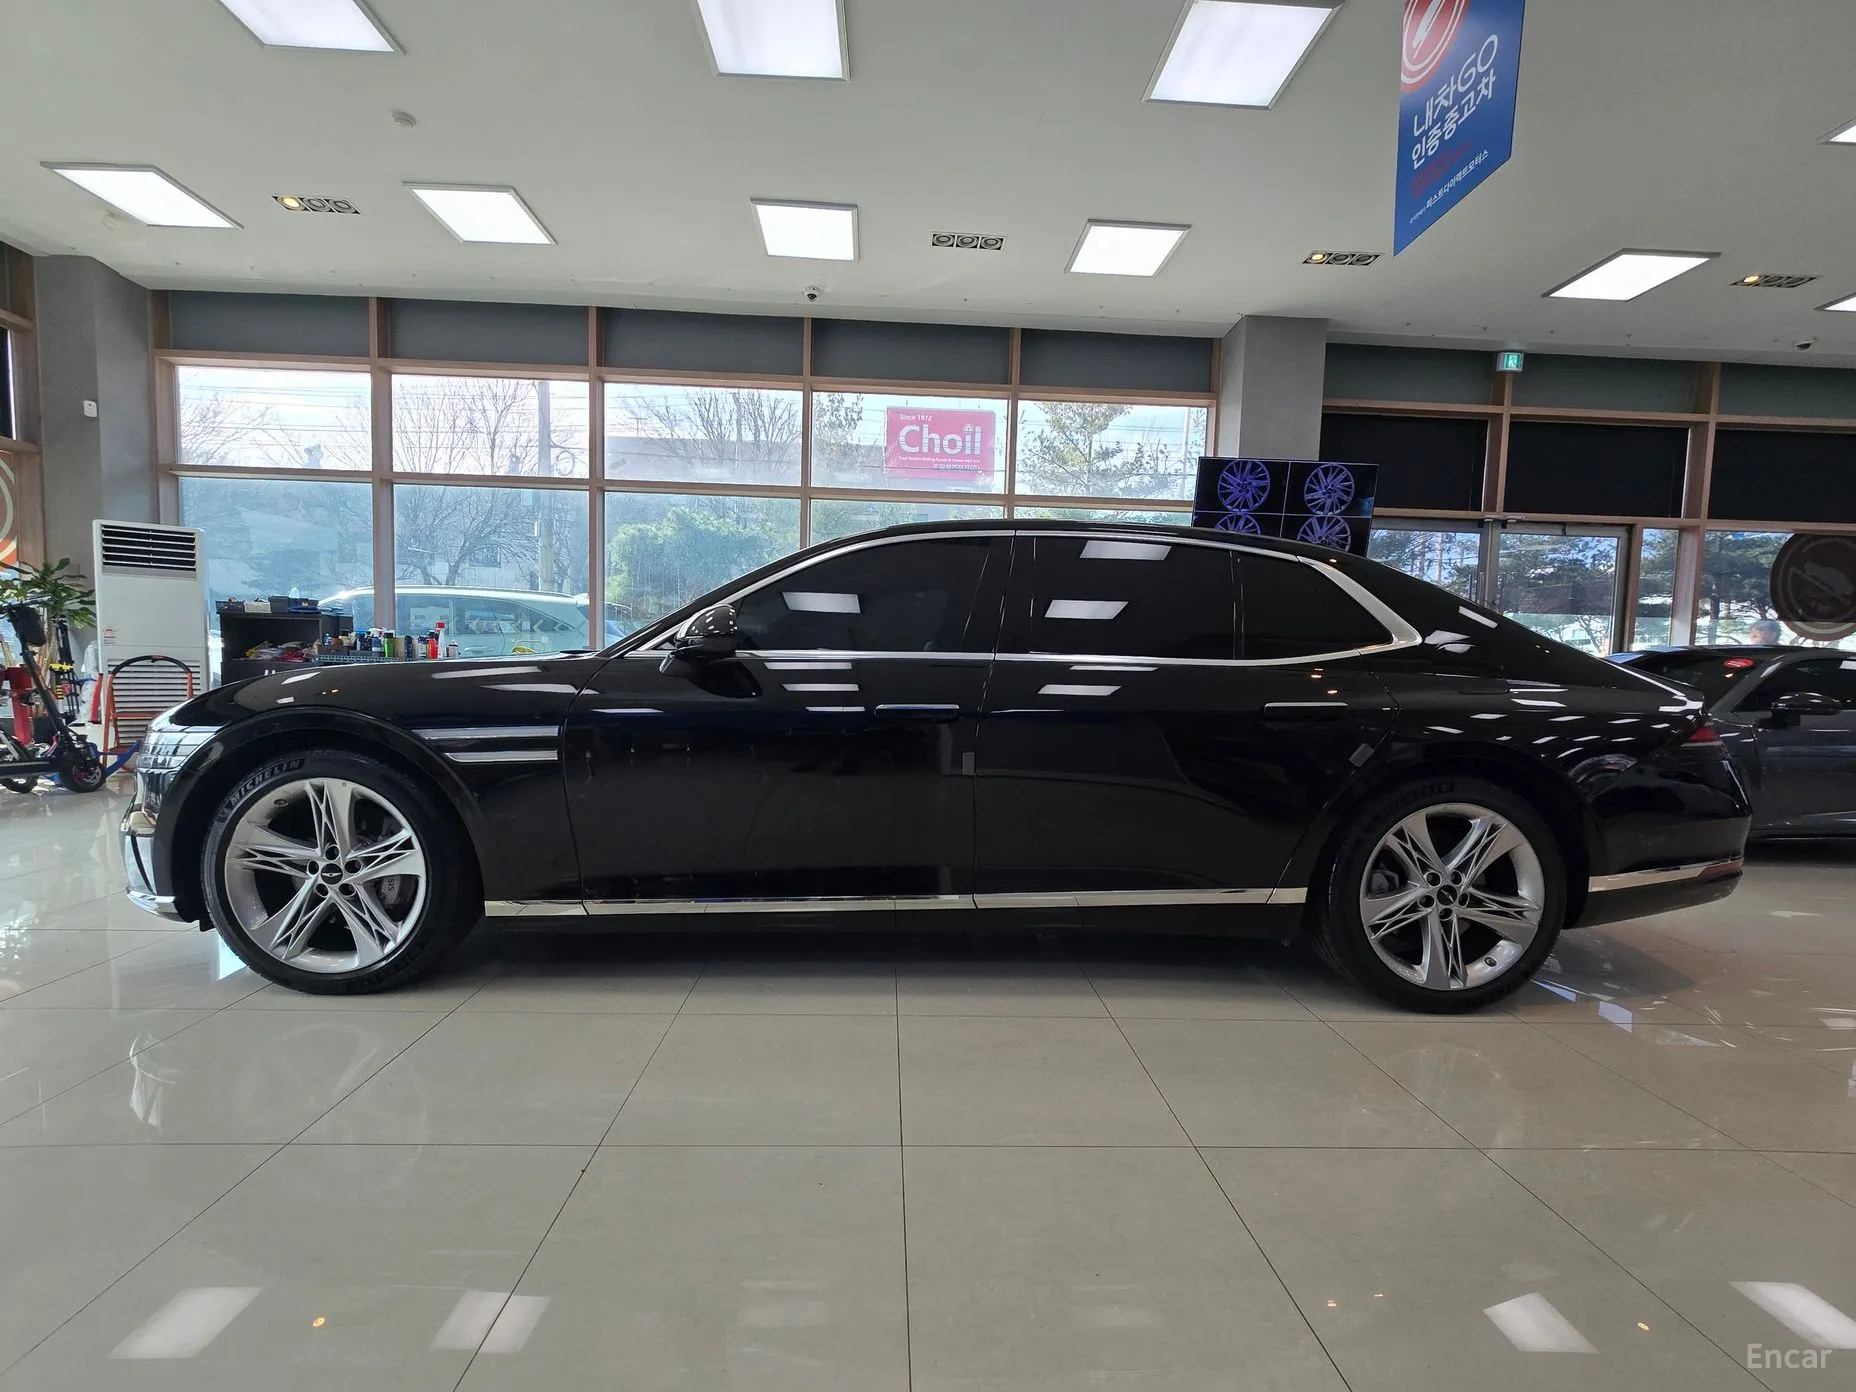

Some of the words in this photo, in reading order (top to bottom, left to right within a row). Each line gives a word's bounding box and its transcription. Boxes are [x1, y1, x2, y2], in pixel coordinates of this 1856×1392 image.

[1413, 34, 1498, 137] 내차GO
[1412, 67, 1496, 170] 인증중고차
[899, 424, 982, 455] Choil
[917, 414, 933, 422] 1972
[230, 760, 301, 807] MICHELIN
